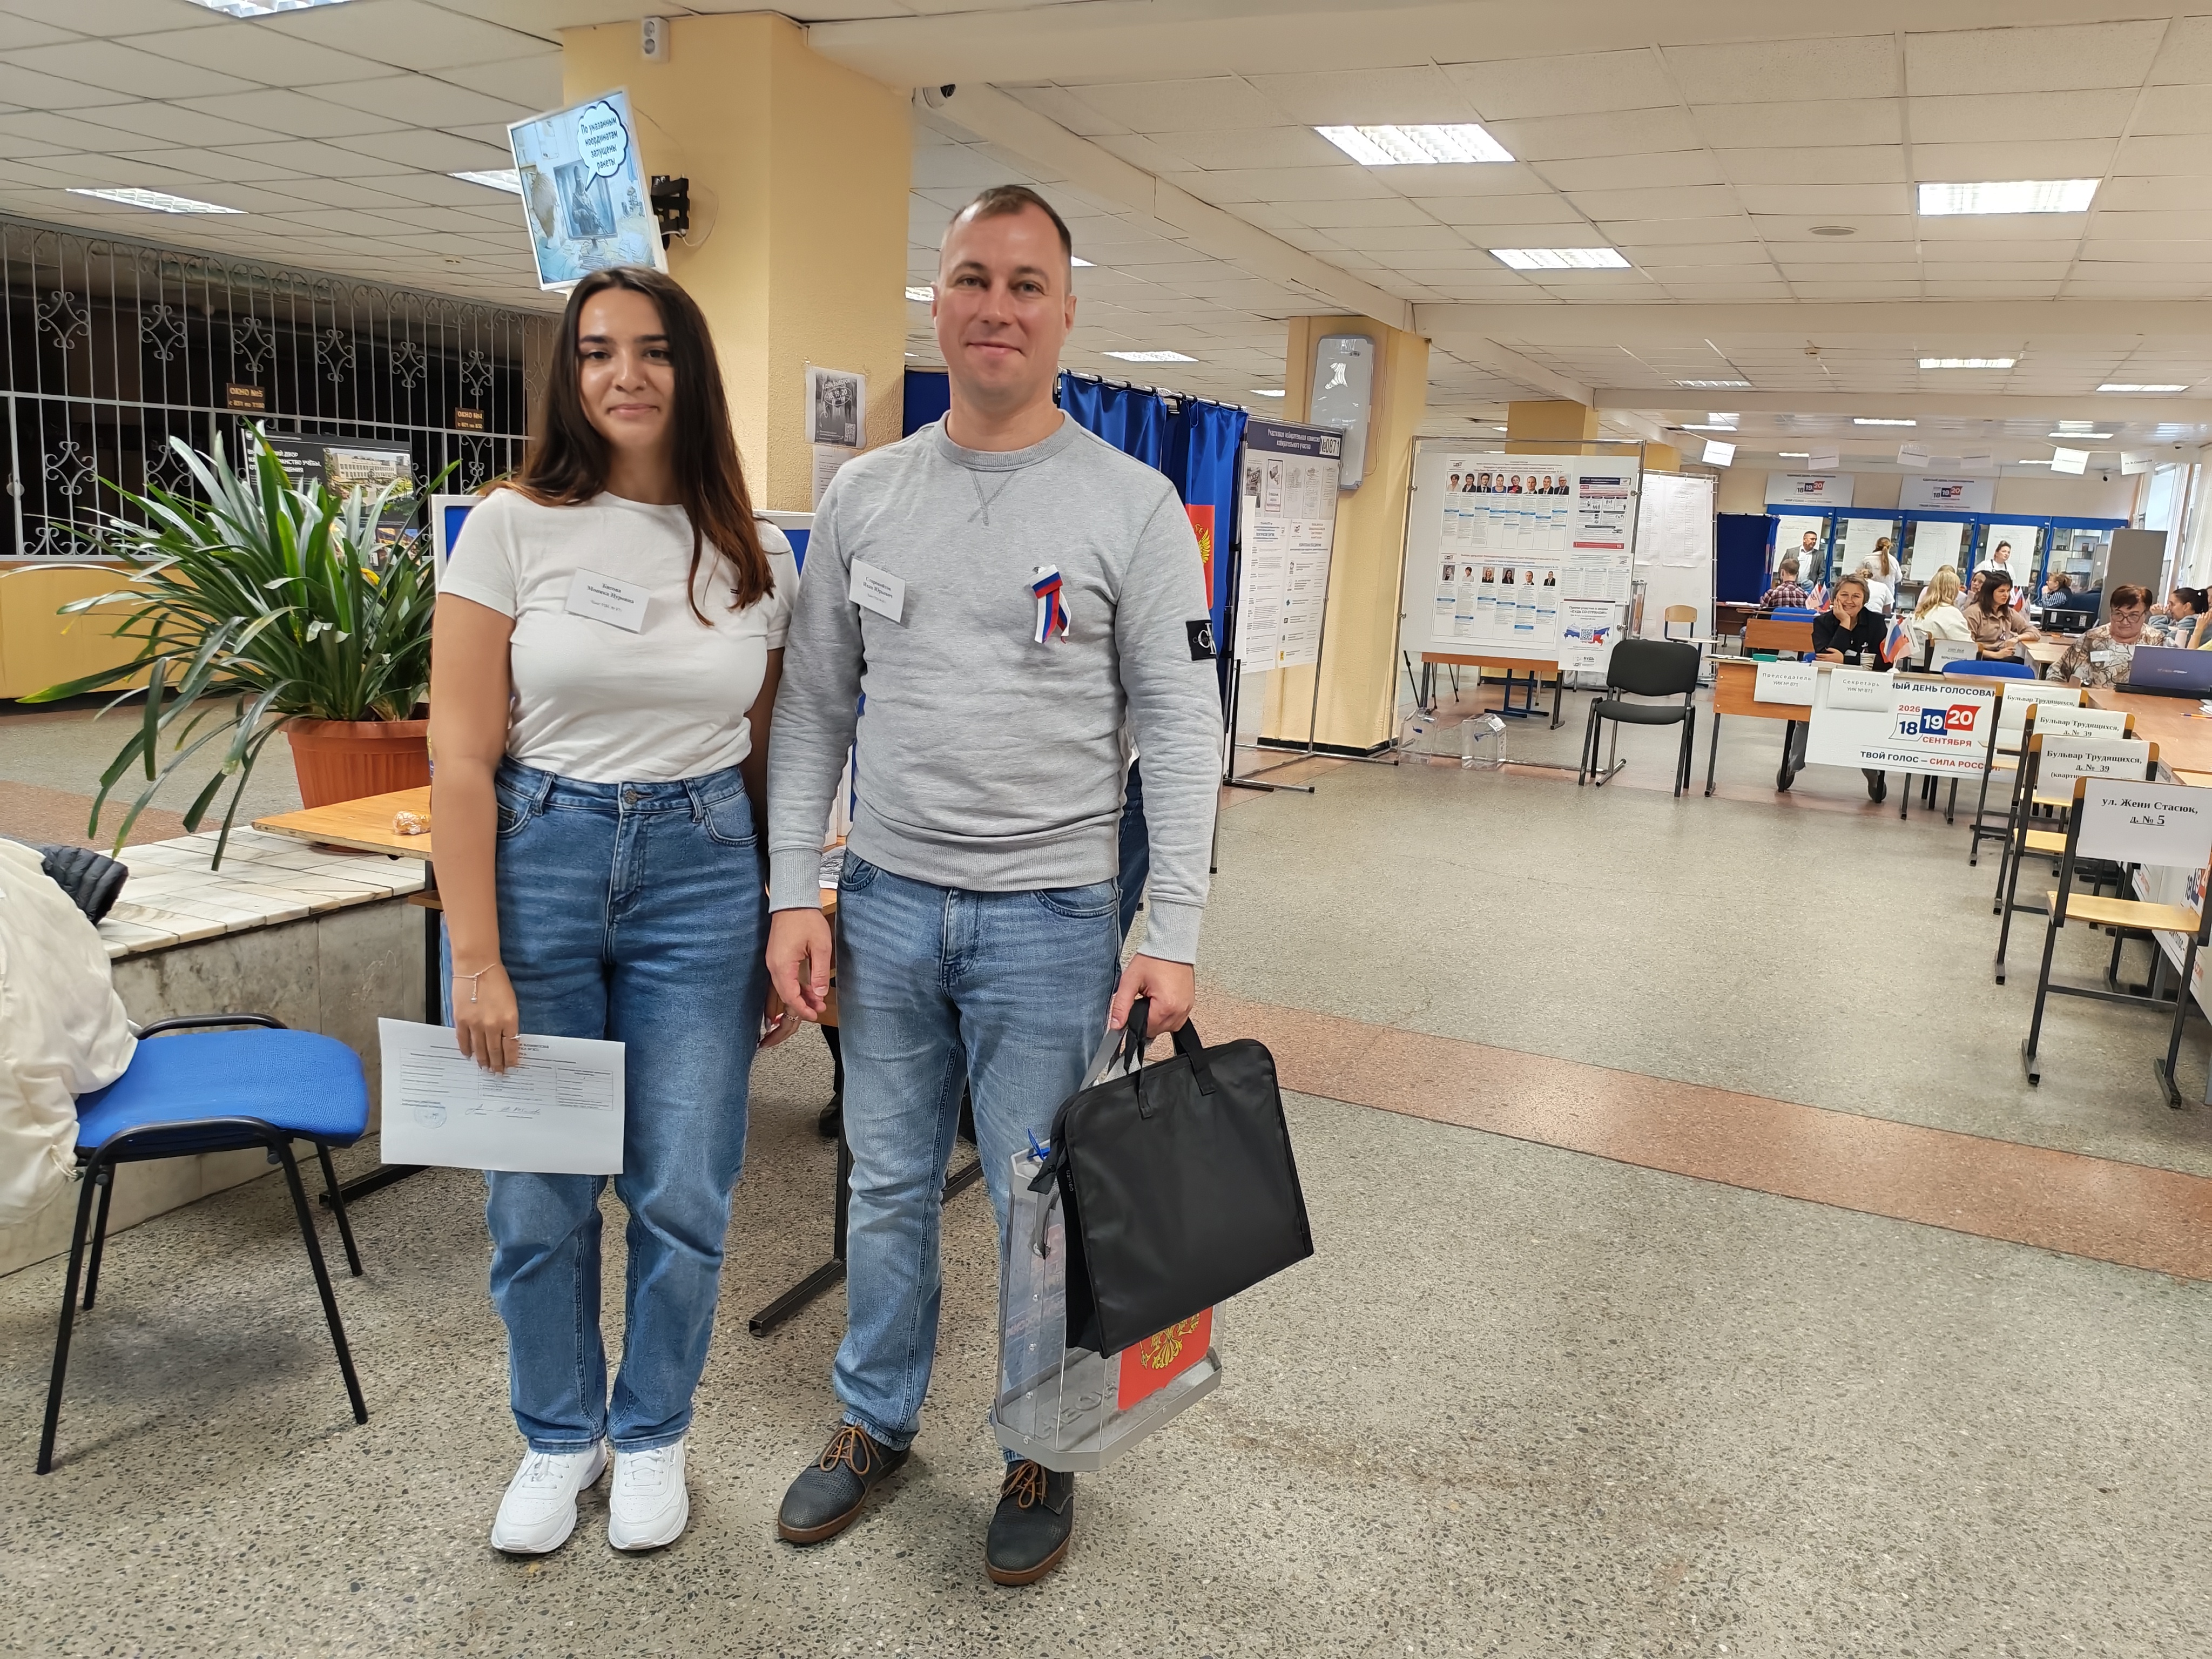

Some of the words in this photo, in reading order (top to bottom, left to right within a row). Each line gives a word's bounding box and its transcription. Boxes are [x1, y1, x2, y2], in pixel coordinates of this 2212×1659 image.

[581, 124, 588, 135] По
[589, 117, 617, 135] указанным
[585, 130, 618, 147] координатам
[591, 144, 617, 158] запущены
[597, 158, 616, 172] ракеты
[1319, 437, 1339, 455] №0871
[1763, 672, 1811, 681] Председатель
[1843, 679, 1880, 687] Секретарь
[1892, 682, 1910, 690] НЫЙ
[1912, 684, 1938, 692] ДЕНЬ
[2007, 695, 2033, 703] Бульвар
[1924, 714, 1943, 730] 19
[1947, 710, 1973, 726] 20
[2040, 717, 2070, 726] Бульвар
[2072, 720, 2119, 731] Трудящихся,
[1899, 721, 1918, 735] 18
[1923, 736, 1972, 747] СЕНТЯБРЯ
[1860, 751, 1885, 760] ТВОЙ
[1887, 753, 1919, 763] ГОЛОС
[1930, 758, 1955, 767] СИЛА
[2047, 750, 2083, 760] Бульвар
[2085, 753, 2142, 764] Трудящихся,
[2101, 798, 2117, 807] ул.
[2120, 798, 2150, 809] Жени
[2154, 801, 2198, 814] Стасюк,
[2143, 815, 2154, 824] №
[2157, 815, 2165, 825] 5
